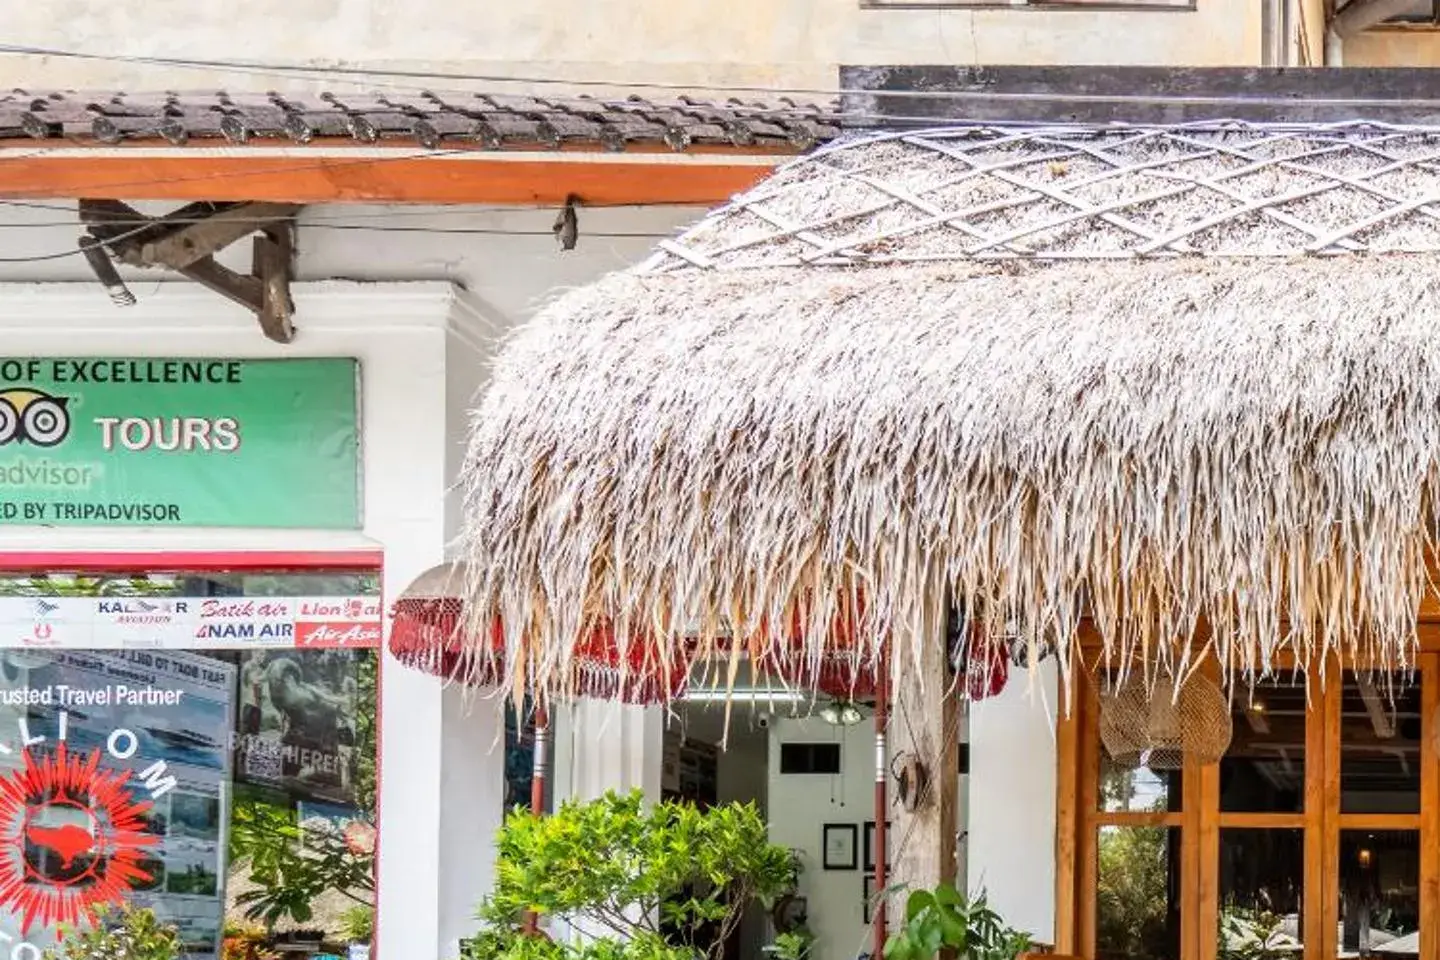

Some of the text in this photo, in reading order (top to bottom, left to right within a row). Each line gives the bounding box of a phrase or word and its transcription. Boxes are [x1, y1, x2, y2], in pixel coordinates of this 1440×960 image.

[1, 361, 242, 384] OF EXCELLENCE
[92, 417, 241, 452] TOURS
[24, 502, 47, 519] BY
[53, 502, 181, 521] TRIPADVISOR
[209, 623, 293, 638] NAM AIR
[0, 684, 185, 706] usted Travel Partner
